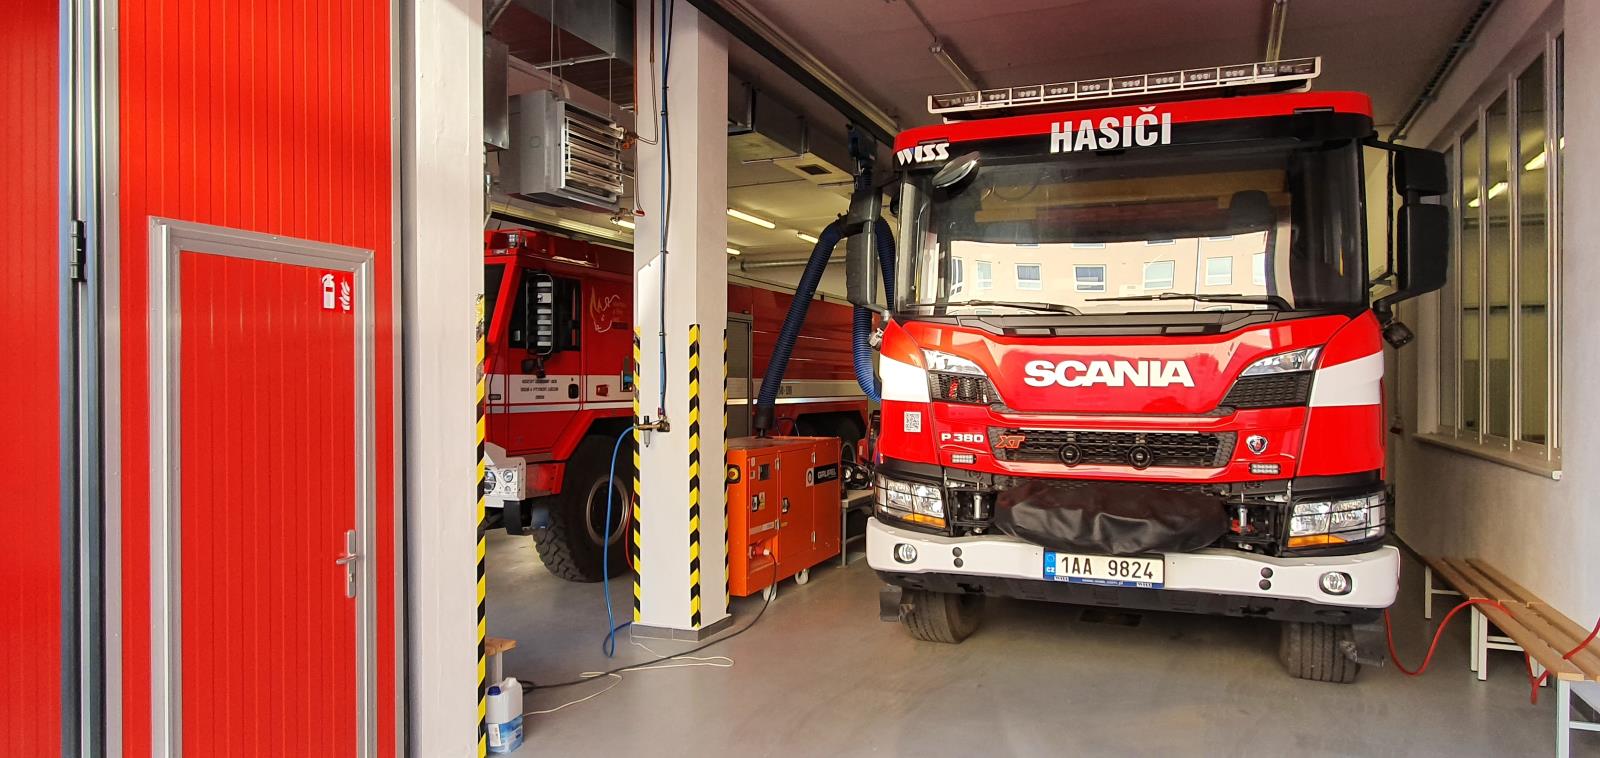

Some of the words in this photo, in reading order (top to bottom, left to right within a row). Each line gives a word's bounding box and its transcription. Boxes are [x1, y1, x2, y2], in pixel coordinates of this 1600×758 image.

[1050, 106, 1172, 154] HASIČI
[896, 143, 950, 166] WISS
[1023, 360, 1195, 388] SCANIA
[941, 432, 952, 442] P
[953, 433, 985, 443] 380
[995, 435, 1026, 449] XT
[1061, 556, 1093, 576] 1AA
[1107, 559, 1154, 580] 9824
